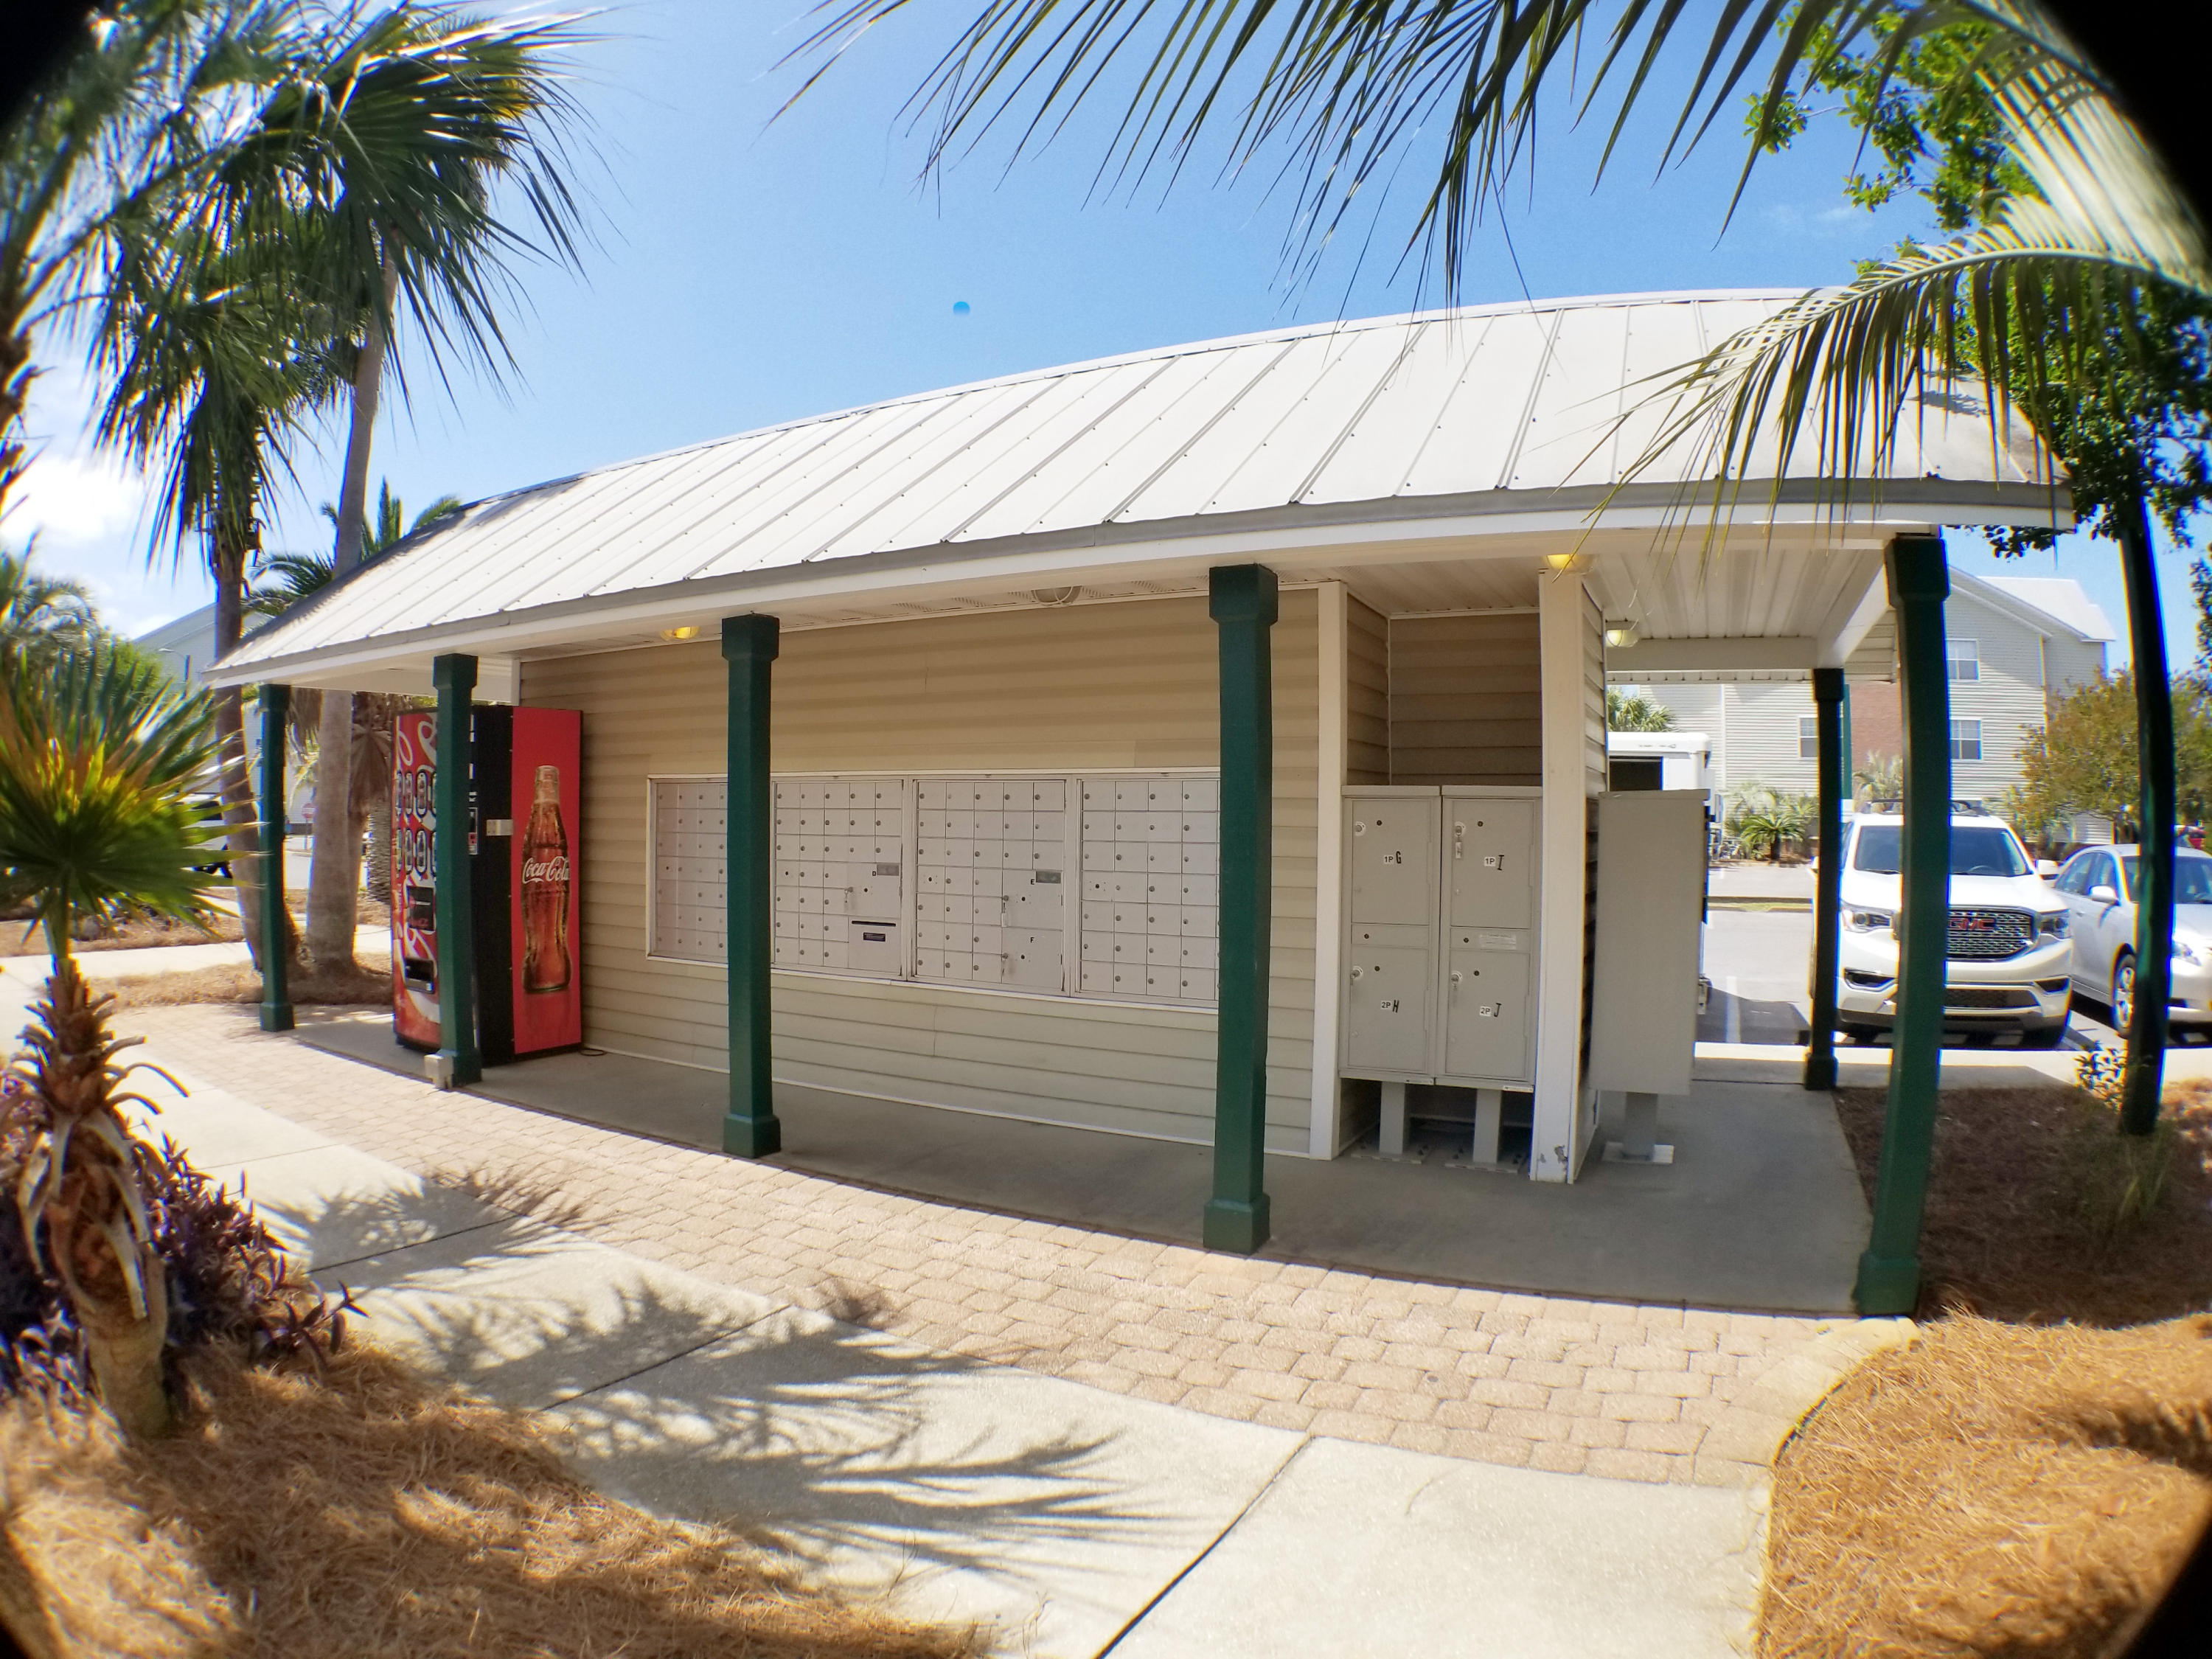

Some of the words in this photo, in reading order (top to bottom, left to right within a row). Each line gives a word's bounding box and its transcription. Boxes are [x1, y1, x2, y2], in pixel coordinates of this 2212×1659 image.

[1396, 851, 1402, 863] G
[1497, 855, 1505, 871] I
[522, 855, 570, 884] Coca-Cola
[1949, 918, 1995, 931] GMC
[1392, 999, 1399, 1013] H
[1494, 1002, 1502, 1018] J
